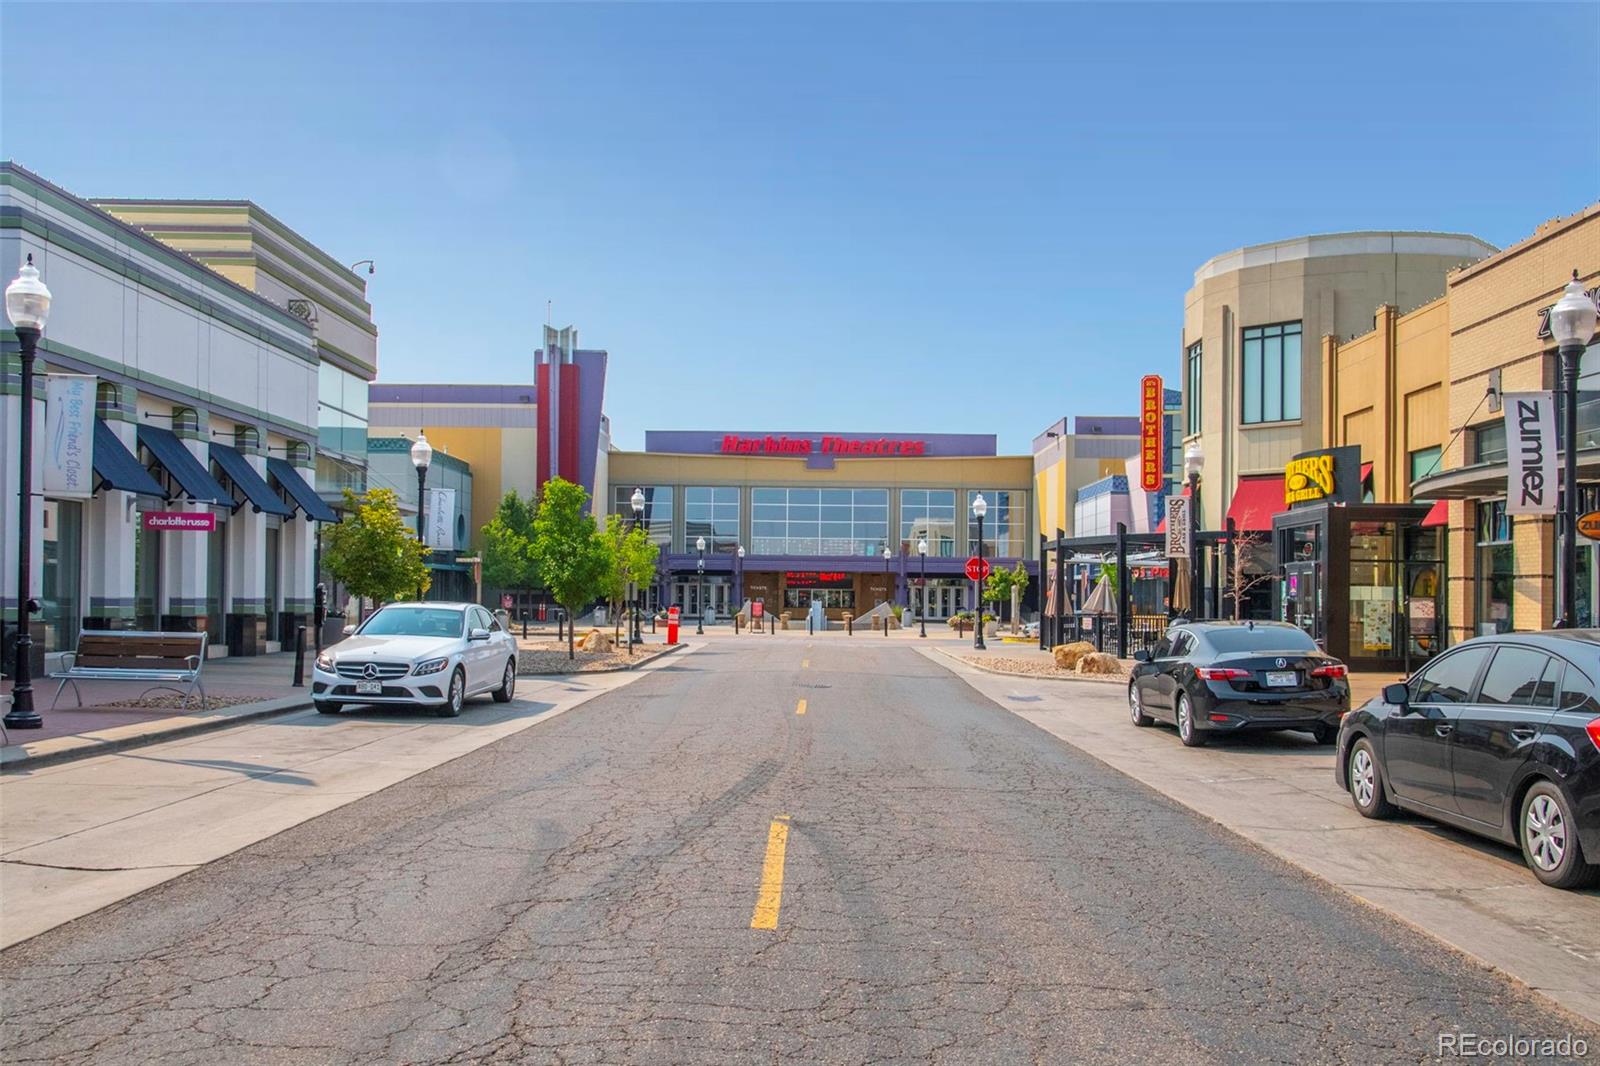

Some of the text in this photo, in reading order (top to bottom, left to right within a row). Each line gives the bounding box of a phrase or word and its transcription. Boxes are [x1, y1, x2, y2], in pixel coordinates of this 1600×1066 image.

[67, 380, 84, 397] My
[69, 399, 83, 418] Best
[67, 420, 82, 457] Friend's
[720, 435, 926, 455] Harkins Theatres
[1145, 387, 1156, 485] BROTHERS
[148, 516, 210, 527] charlotte russe
[1170, 498, 1185, 554] BROTHERS
[967, 565, 989, 573] STOP
